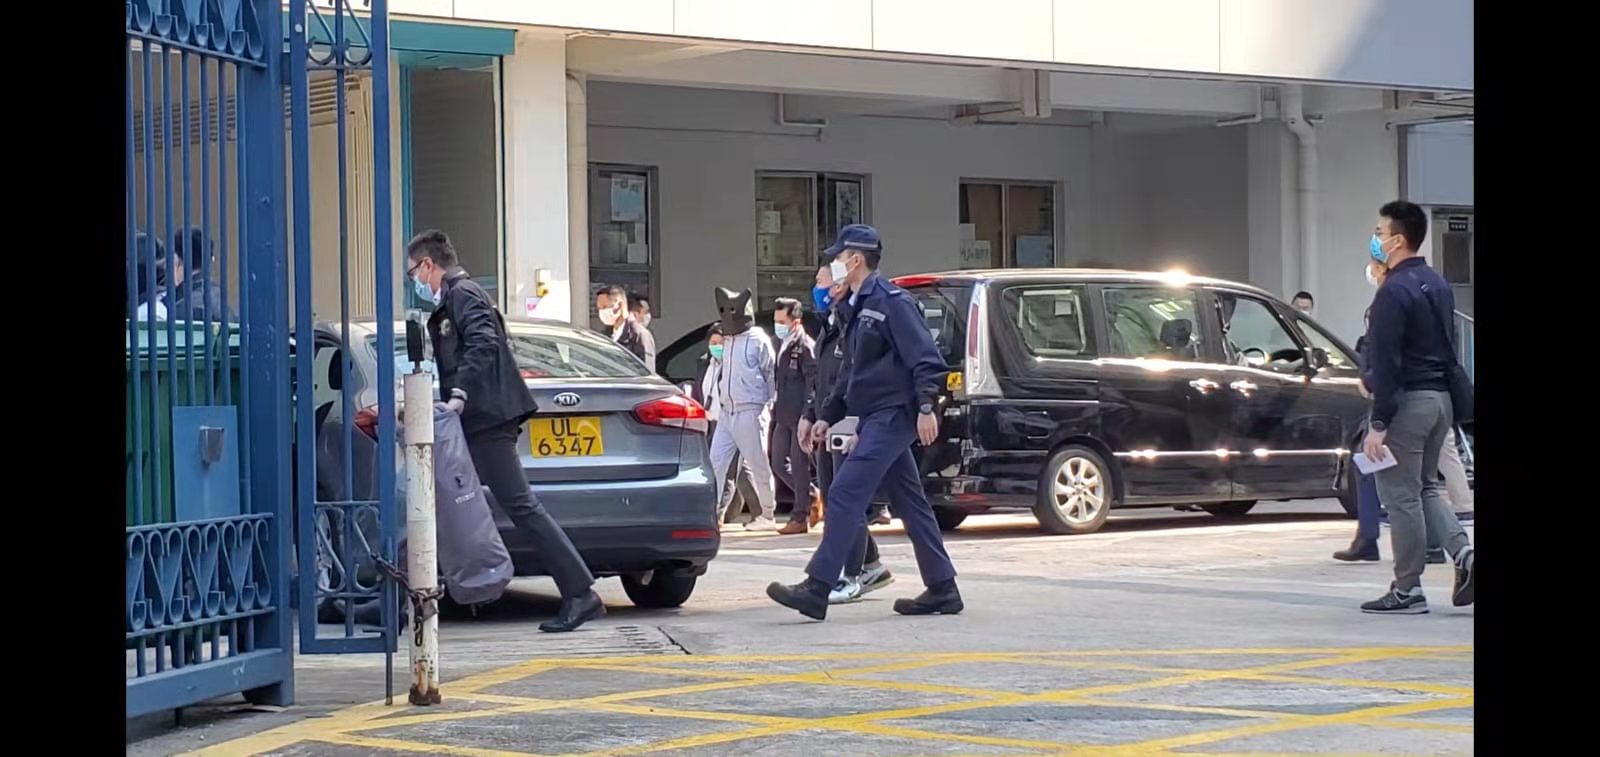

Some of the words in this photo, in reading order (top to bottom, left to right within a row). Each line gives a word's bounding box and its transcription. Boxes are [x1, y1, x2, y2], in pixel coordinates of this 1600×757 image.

[557, 395, 578, 406] KIA
[551, 418, 579, 436] UL
[538, 436, 596, 456] 6347
